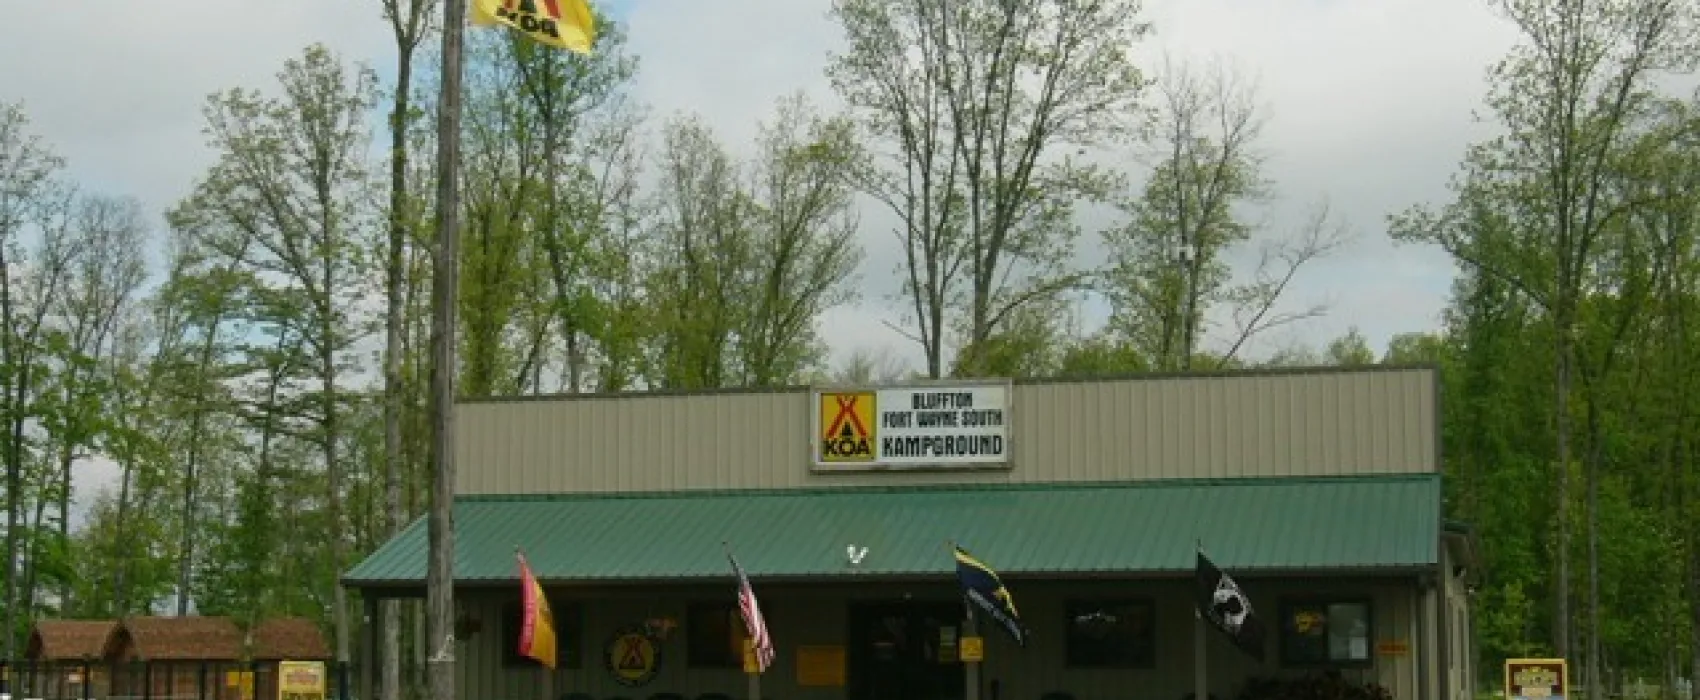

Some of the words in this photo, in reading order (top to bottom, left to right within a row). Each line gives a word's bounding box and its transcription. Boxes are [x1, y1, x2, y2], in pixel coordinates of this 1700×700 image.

[912, 392, 973, 409] BLUFFTON
[882, 411, 912, 428] FORT
[917, 410, 959, 428] WAYNE
[962, 409, 1002, 427] SOUTH
[823, 437, 871, 455] KOA
[882, 435, 1003, 457] KAMPGROUND
